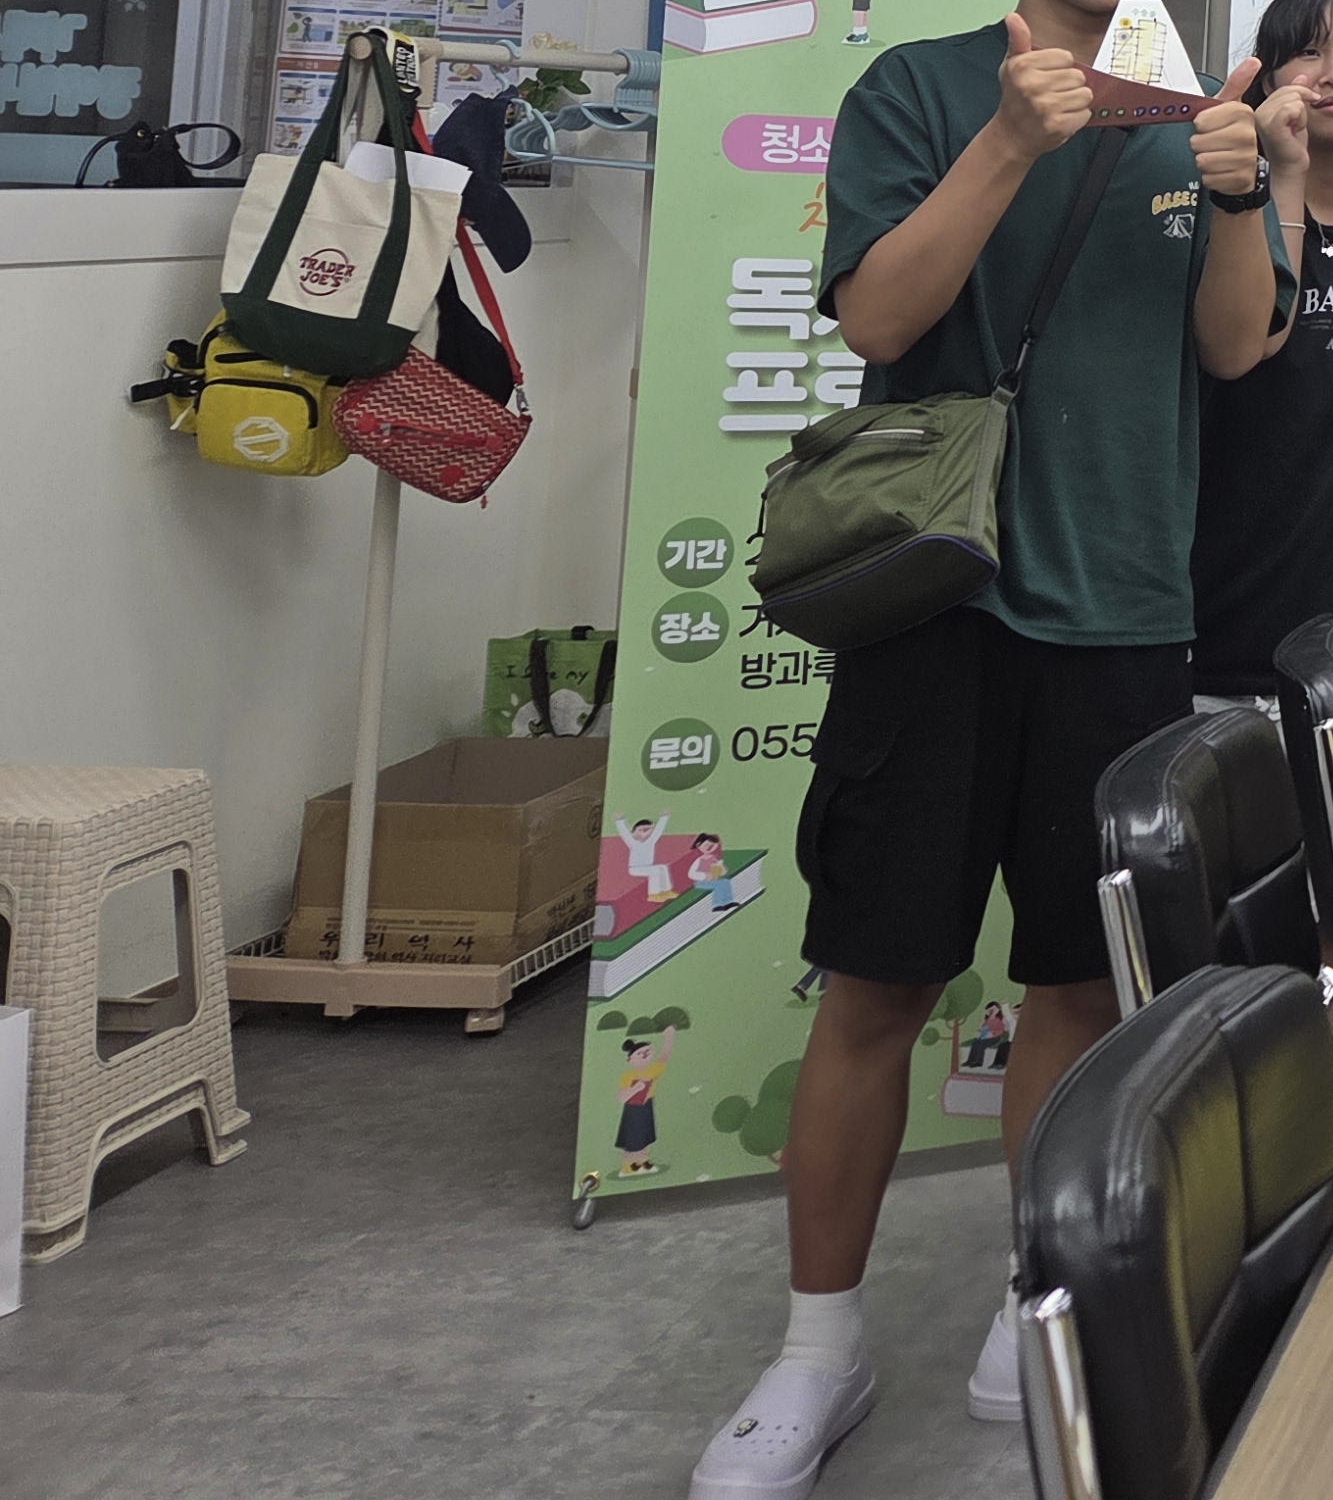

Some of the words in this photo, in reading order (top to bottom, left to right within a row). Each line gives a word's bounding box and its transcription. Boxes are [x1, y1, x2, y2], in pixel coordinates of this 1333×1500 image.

[299, 256, 356, 277] TRADER
[300, 271, 344, 287] JOE'S
[726, 257, 839, 340] 독
[664, 539, 727, 570] 기간
[659, 612, 721, 645] 장소
[649, 734, 713, 770] 문의
